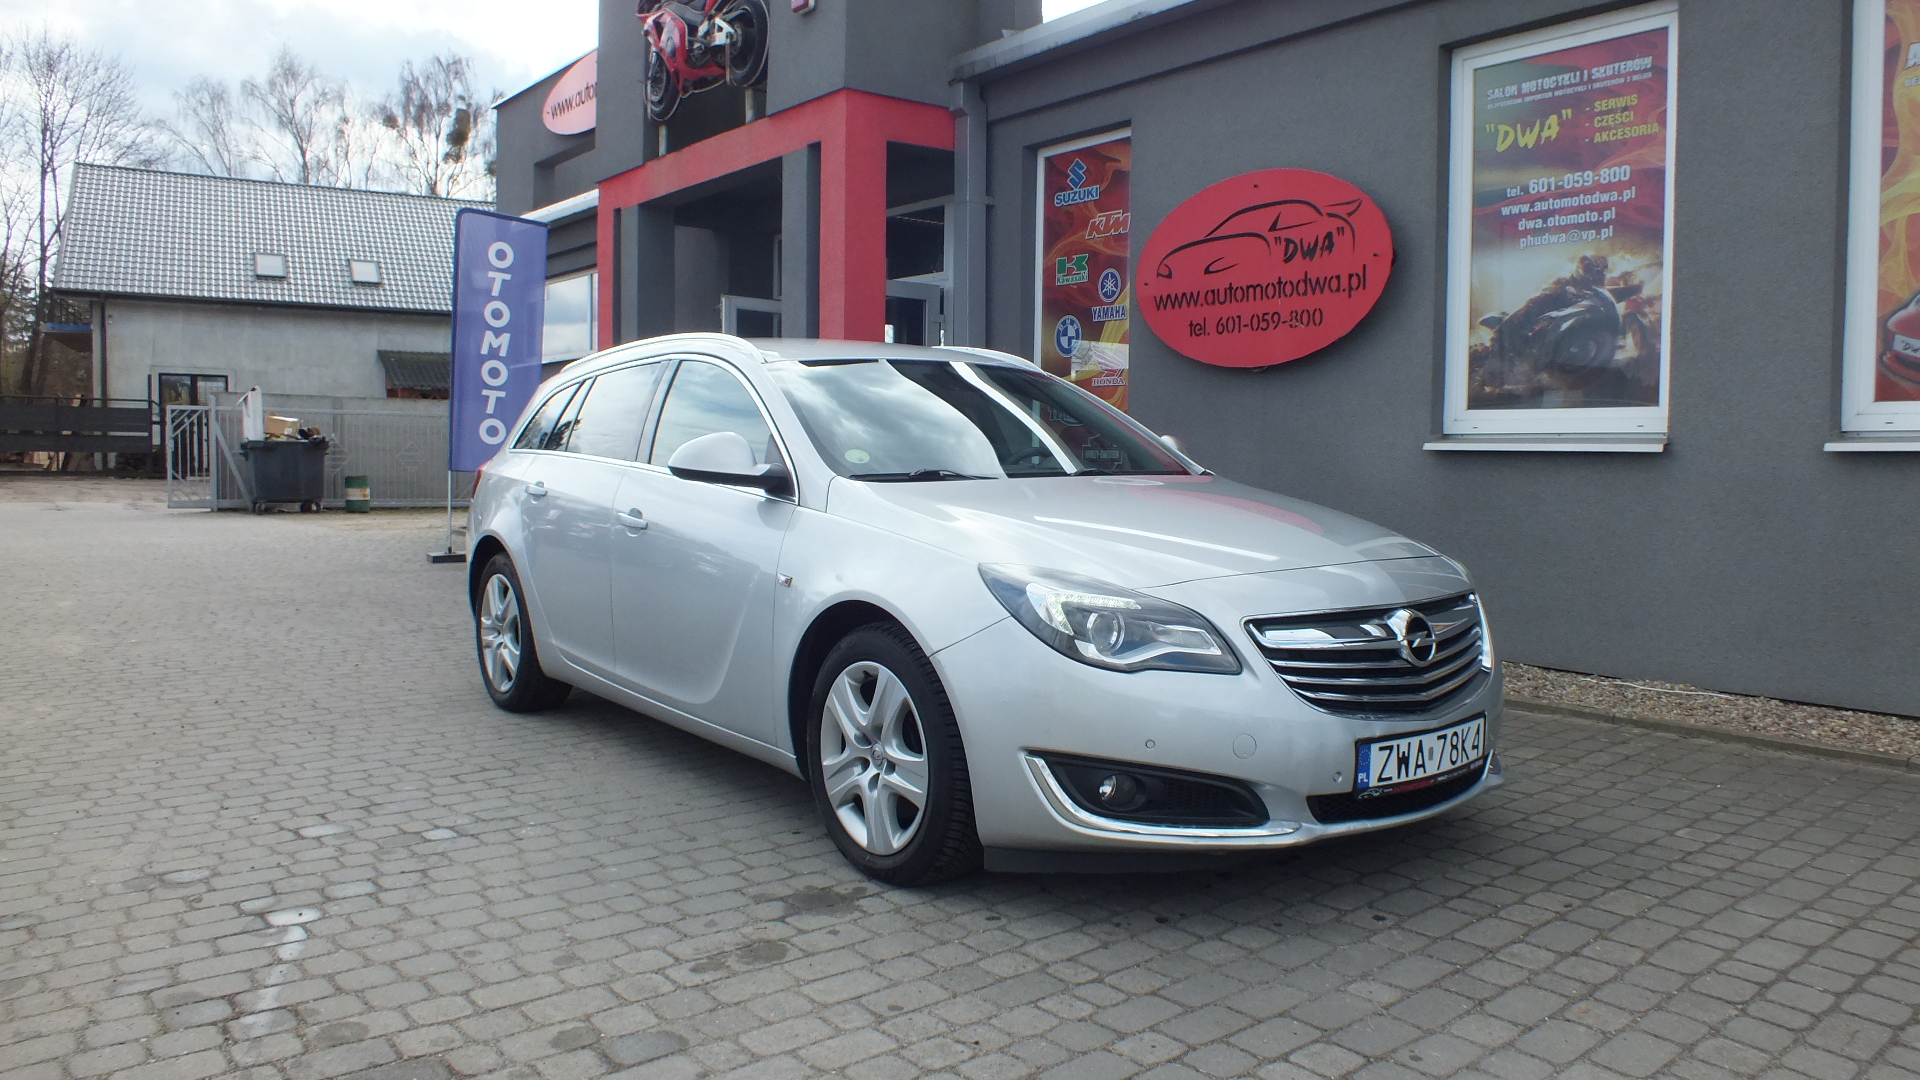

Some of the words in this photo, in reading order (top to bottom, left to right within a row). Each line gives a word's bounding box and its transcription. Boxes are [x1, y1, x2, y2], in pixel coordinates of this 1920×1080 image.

[1487, 86, 1518, 100] SALON
[1521, 71, 1580, 94] MOTOCYKLI
[1583, 69, 1588, 82] I
[1591, 54, 1653, 80] SKUTERÓW
[551, 82, 597, 120] www.auto
[1594, 94, 1638, 113] SERWIS
[1486, 109, 1572, 153] "DWA"
[1594, 110, 1634, 129] CZĘŚCI
[1594, 122, 1659, 144] AKCESORIA
[1055, 186, 1099, 206] SUZUKI
[1506, 187, 1524, 198] tel.
[1529, 165, 1631, 194] 601-059-800
[1501, 186, 1636, 216] www.automotodwa.pl
[1086, 210, 1131, 239] KTM
[1518, 207, 1616, 231] dwa.otomoto.pl
[1274, 227, 1345, 264] "DWA"
[1519, 225, 1613, 249] phudwa@vp.pl
[1057, 274, 1088, 285] Kawasaki
[1154, 264, 1367, 312] www.automotodwa.pl
[1093, 305, 1126, 321] YAMAHA
[1189, 317, 1210, 337] tel.
[1216, 307, 1324, 335] 601-059-800
[478, 241, 515, 445] OTOMOTO
[1093, 377, 1125, 386] HONDA
[1377, 739, 1427, 783] ZWA
[1436, 723, 1481, 771] 78K4
[1358, 773, 1368, 784] PL
